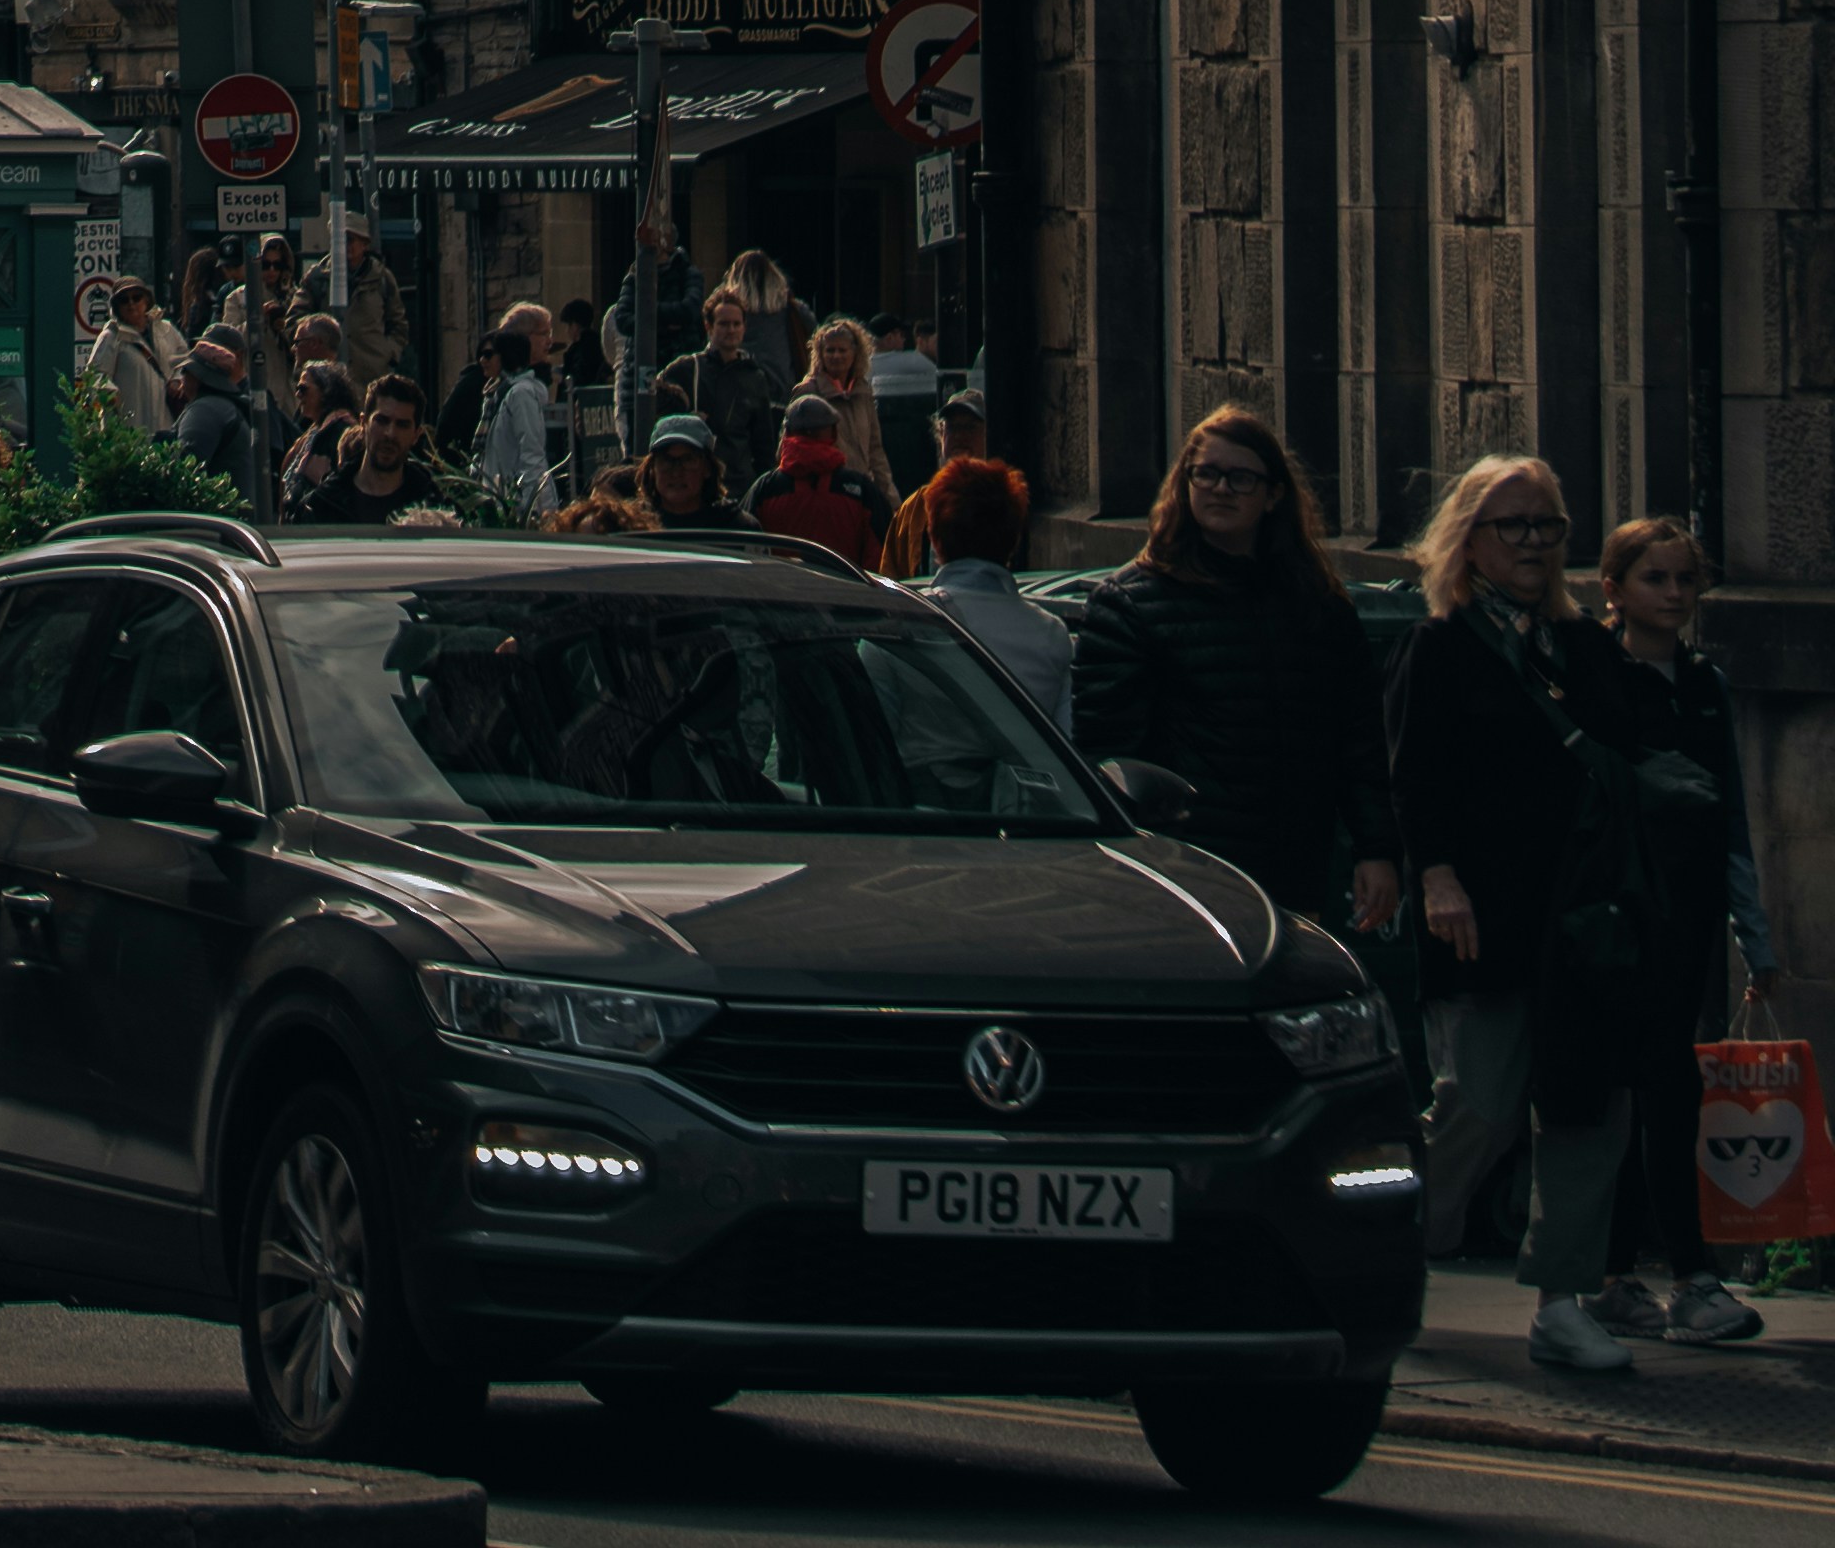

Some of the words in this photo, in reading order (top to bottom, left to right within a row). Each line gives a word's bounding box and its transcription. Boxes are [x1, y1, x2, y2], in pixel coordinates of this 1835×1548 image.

[737, 28, 801, 43] GRASSMARKET
[113, 95, 143, 117] THE
[434, 168, 452, 188] TO
[468, 168, 523, 188] BIDDY
[223, 191, 280, 208] Except
[226, 209, 278, 225] cycles
[1696, 1051, 1800, 1091] Squish
[900, 1170, 1018, 1225] PG18
[1039, 1173, 1141, 1229] NZX
